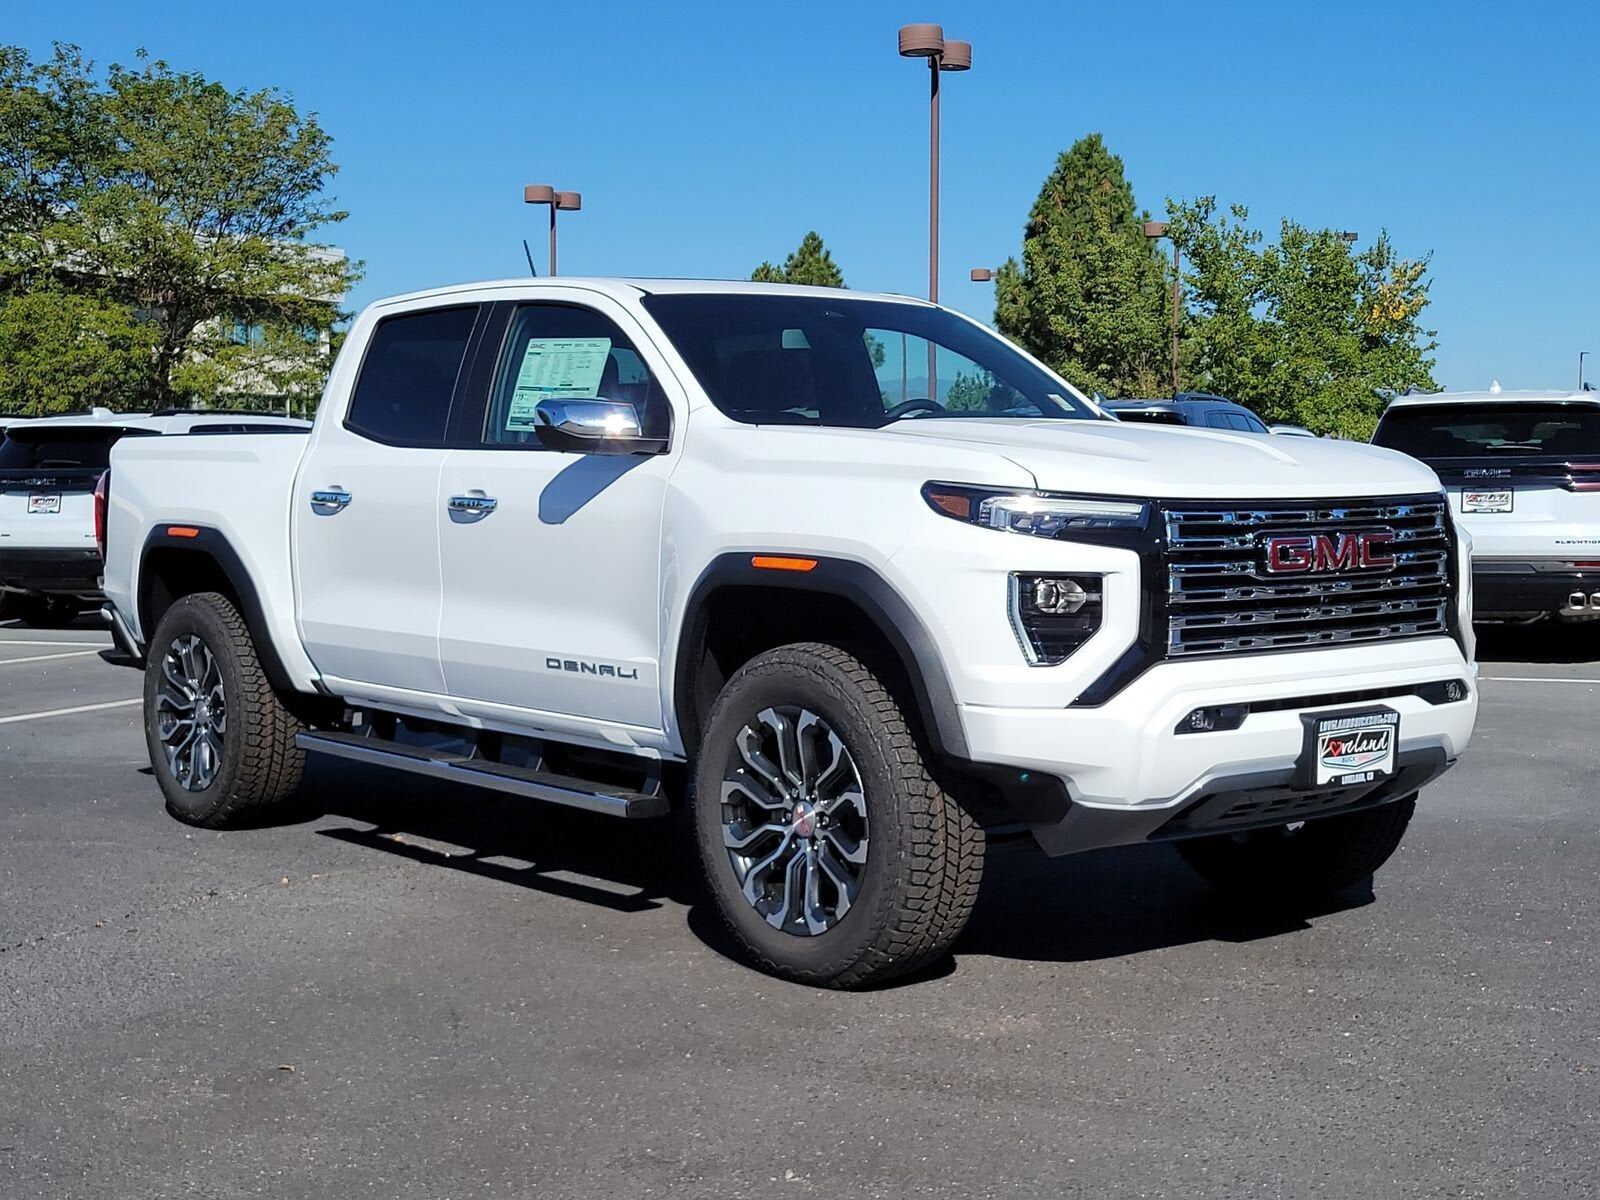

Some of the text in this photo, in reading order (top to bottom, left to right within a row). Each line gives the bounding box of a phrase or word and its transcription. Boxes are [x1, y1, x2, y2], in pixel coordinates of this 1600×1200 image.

[1464, 468, 1511, 479] GMC
[1267, 533, 1396, 572] GMC
[546, 657, 638, 680] DENALI
